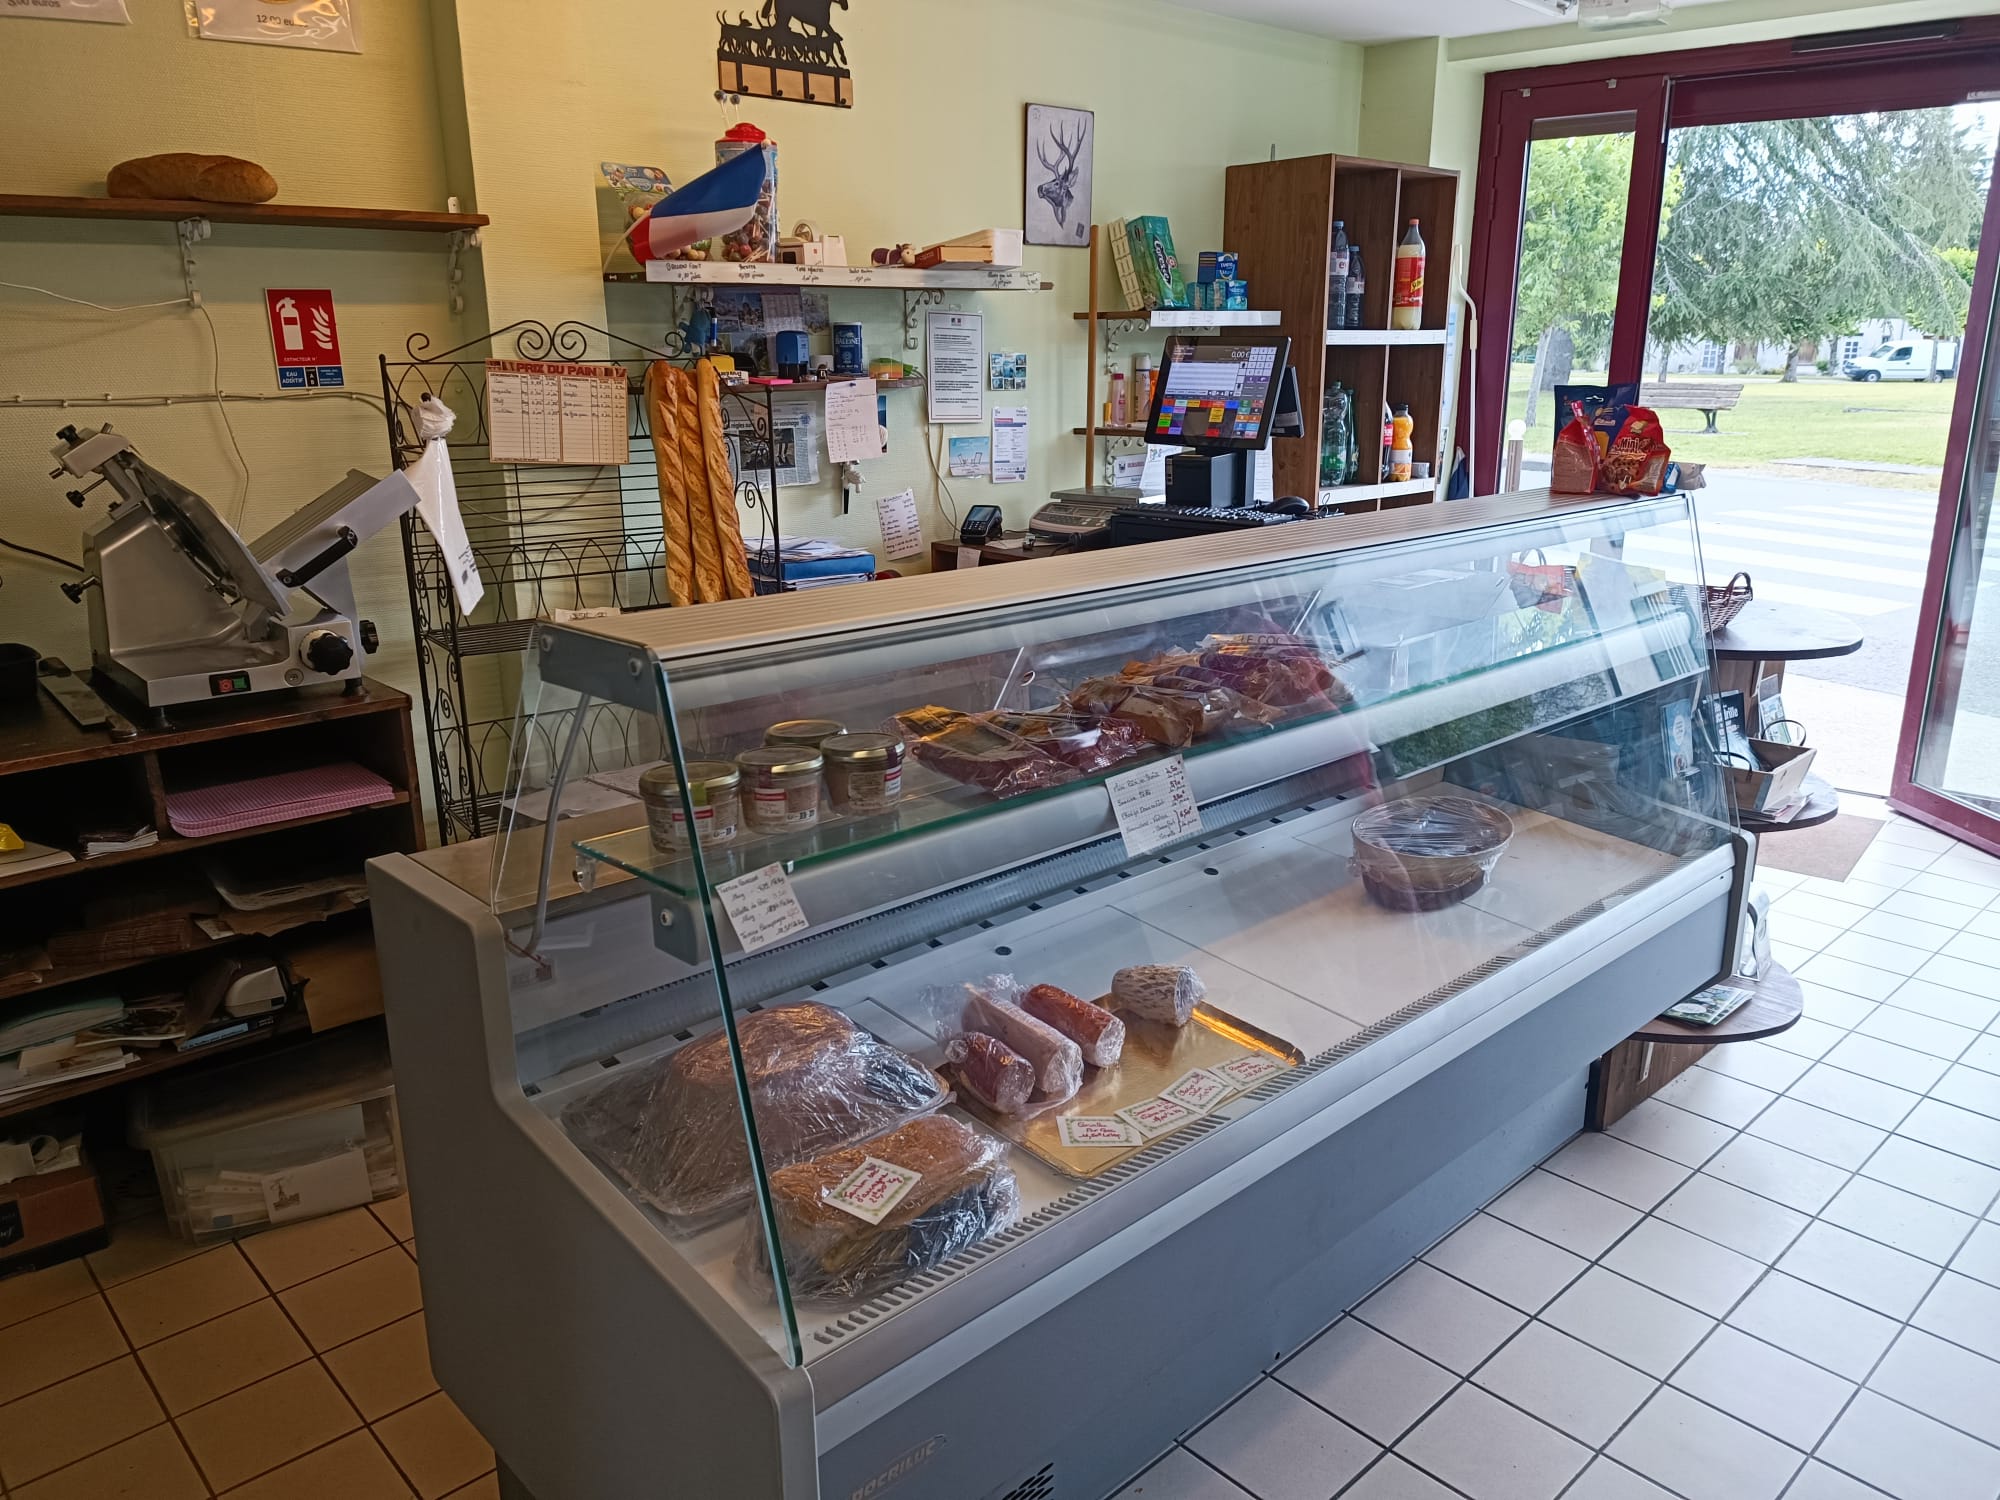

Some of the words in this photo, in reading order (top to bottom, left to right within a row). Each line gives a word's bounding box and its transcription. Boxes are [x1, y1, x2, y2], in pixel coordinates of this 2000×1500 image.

[516, 362, 545, 374] PRIX
[547, 364, 565, 375] DU
[567, 365, 597, 376] PAIN
[1619, 437, 1640, 452] Mini
